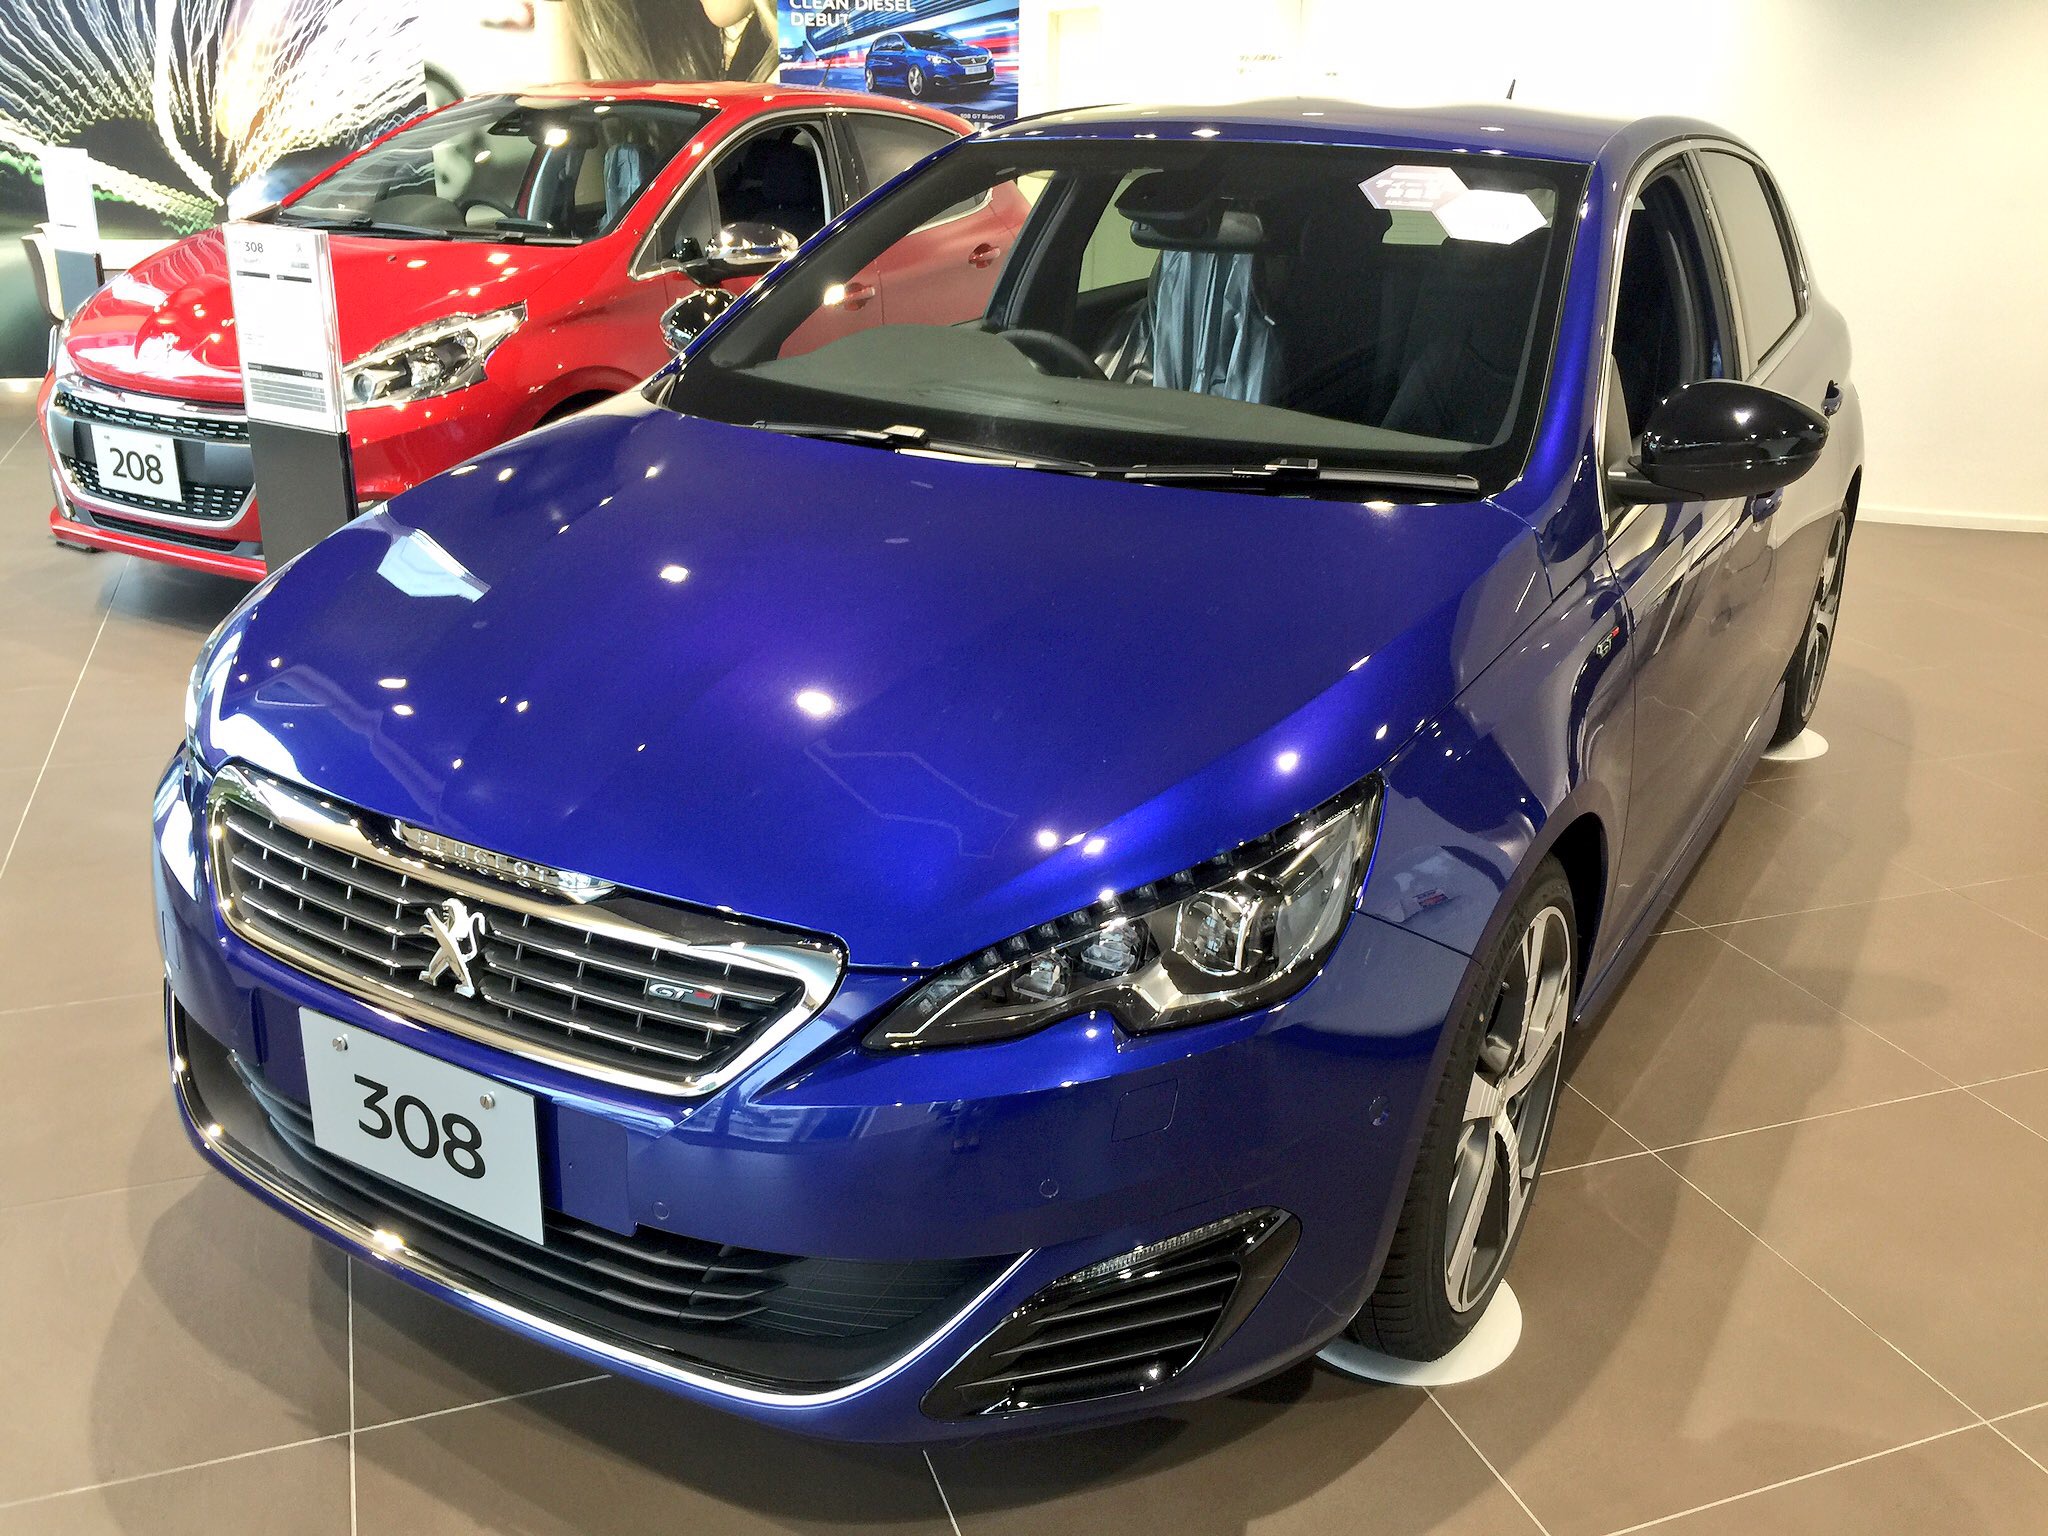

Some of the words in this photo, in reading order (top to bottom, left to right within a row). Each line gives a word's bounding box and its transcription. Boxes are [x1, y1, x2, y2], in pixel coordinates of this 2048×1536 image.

[790, 0, 849, 10] CLEAN
[855, 0, 916, 12] DIESEL
[790, 12, 851, 27] DEBUT
[244, 241, 264, 253] 308
[109, 447, 164, 485] 208
[417, 831, 550, 882] PEUGEOT
[648, 983, 694, 1001] GT
[353, 1073, 486, 1180] 308
